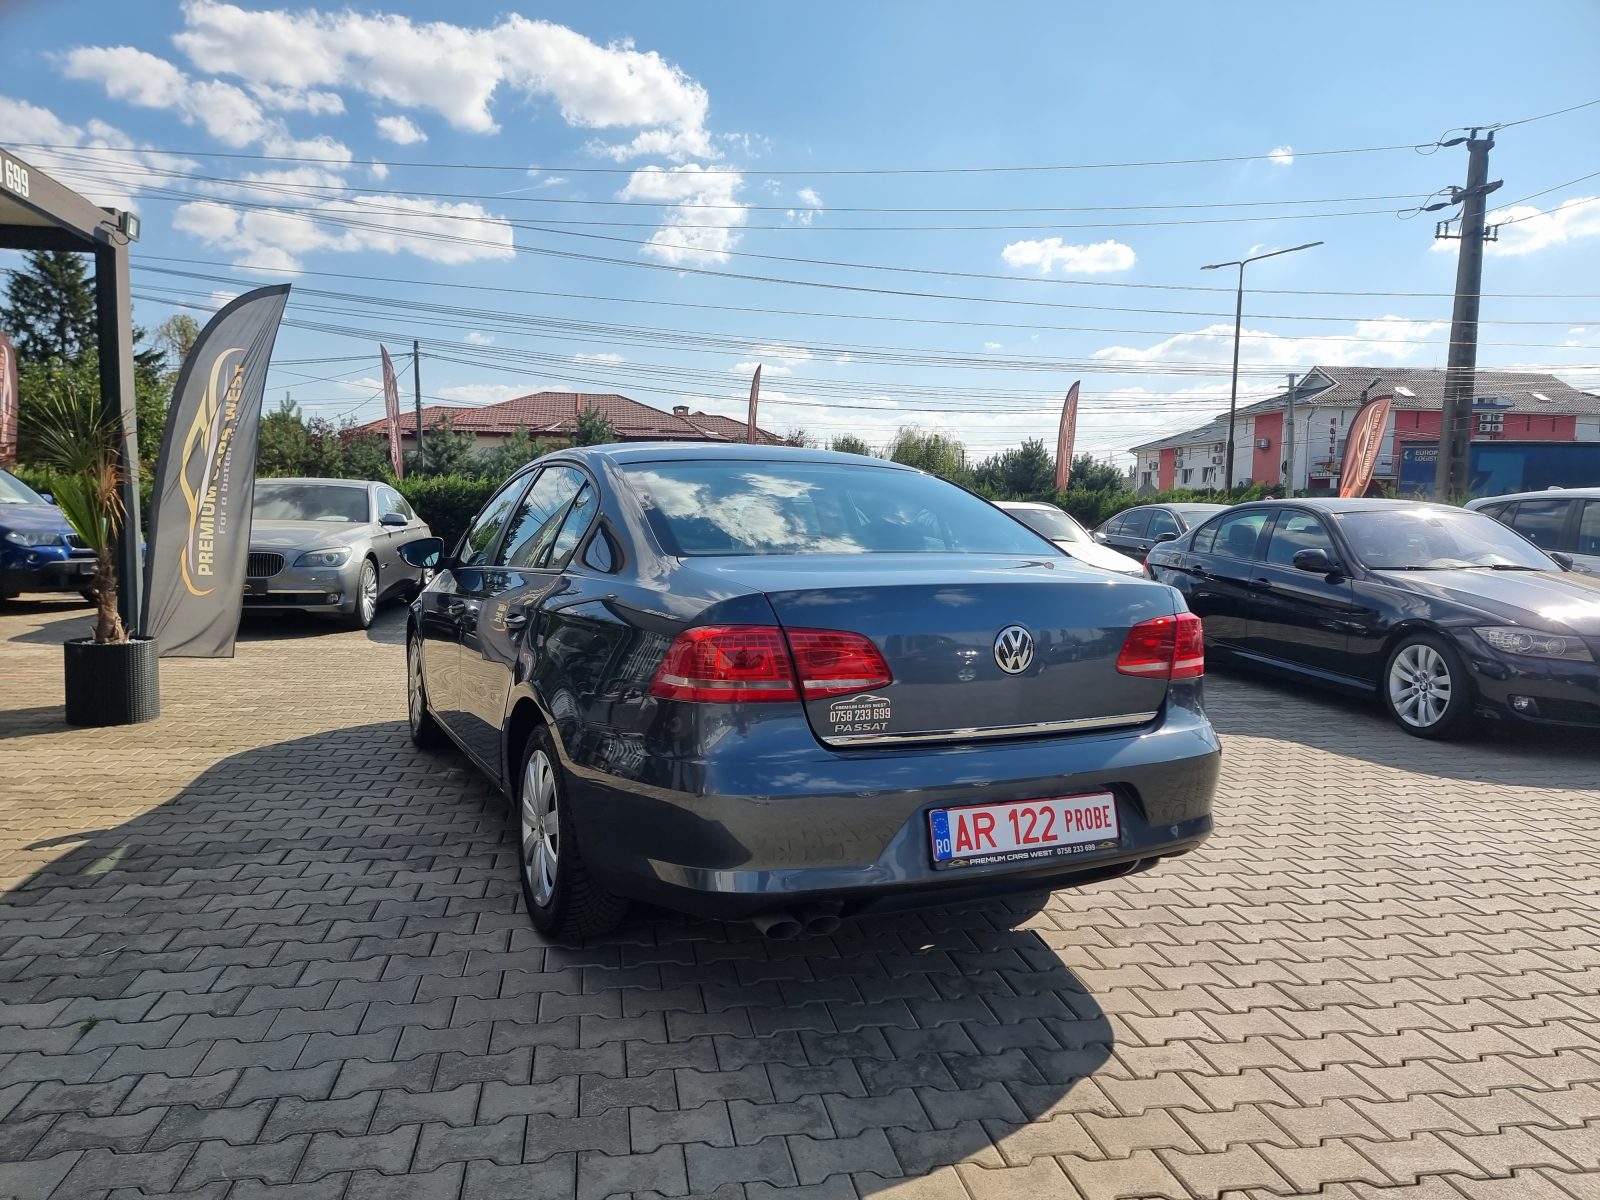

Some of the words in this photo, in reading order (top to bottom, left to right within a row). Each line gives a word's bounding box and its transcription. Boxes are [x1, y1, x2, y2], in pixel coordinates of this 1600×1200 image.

[5, 159, 29, 198] 699
[198, 486, 217, 576] PREMIUM
[224, 364, 245, 422] WEST
[221, 447, 232, 494] better
[221, 497, 228, 506] a
[219, 510, 227, 534] For
[830, 710, 853, 722] 0758
[854, 709, 871, 721] 233
[873, 707, 891, 720] 699
[834, 722, 889, 732] PASSAT
[955, 812, 997, 852] AR
[1008, 805, 1058, 846] 122
[1064, 805, 1112, 833] PROBE
[936, 838, 950, 854] RO
[969, 854, 1006, 866] PREMIUM
[1007, 852, 1029, 862] CARS
[1030, 849, 1053, 859] WEST
[1056, 846, 1073, 856] 0758
[1073, 844, 1084, 854] 233
[1084, 843, 1096, 852] 699
